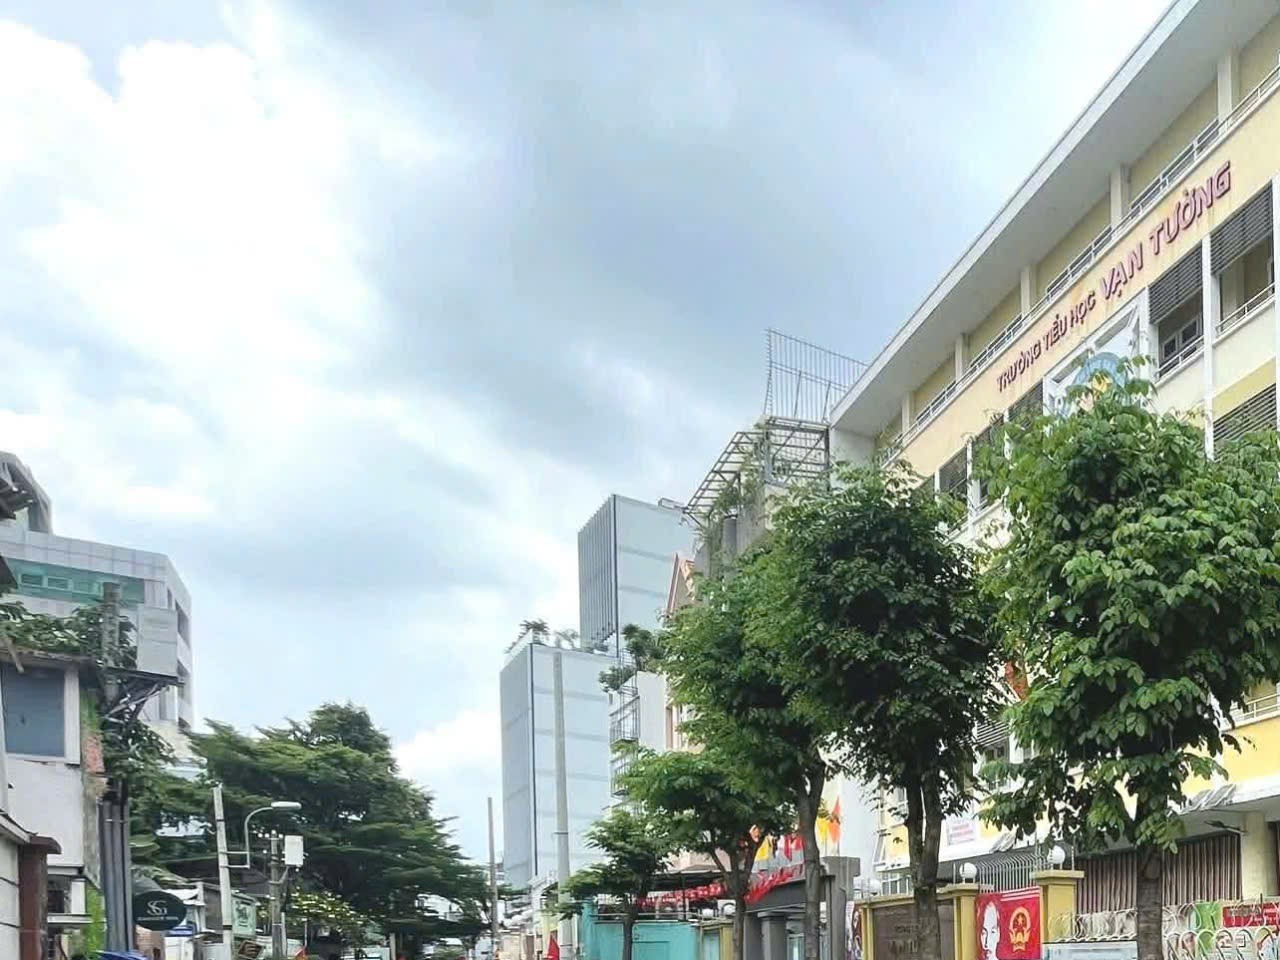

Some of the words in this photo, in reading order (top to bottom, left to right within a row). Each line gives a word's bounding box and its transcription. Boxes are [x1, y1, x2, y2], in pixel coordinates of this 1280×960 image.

[1043, 313, 1068, 351] TIỂU
[1070, 290, 1097, 327] HỌC
[1101, 243, 1144, 298] VẠN
[1149, 160, 1231, 256] TƯỜNG
